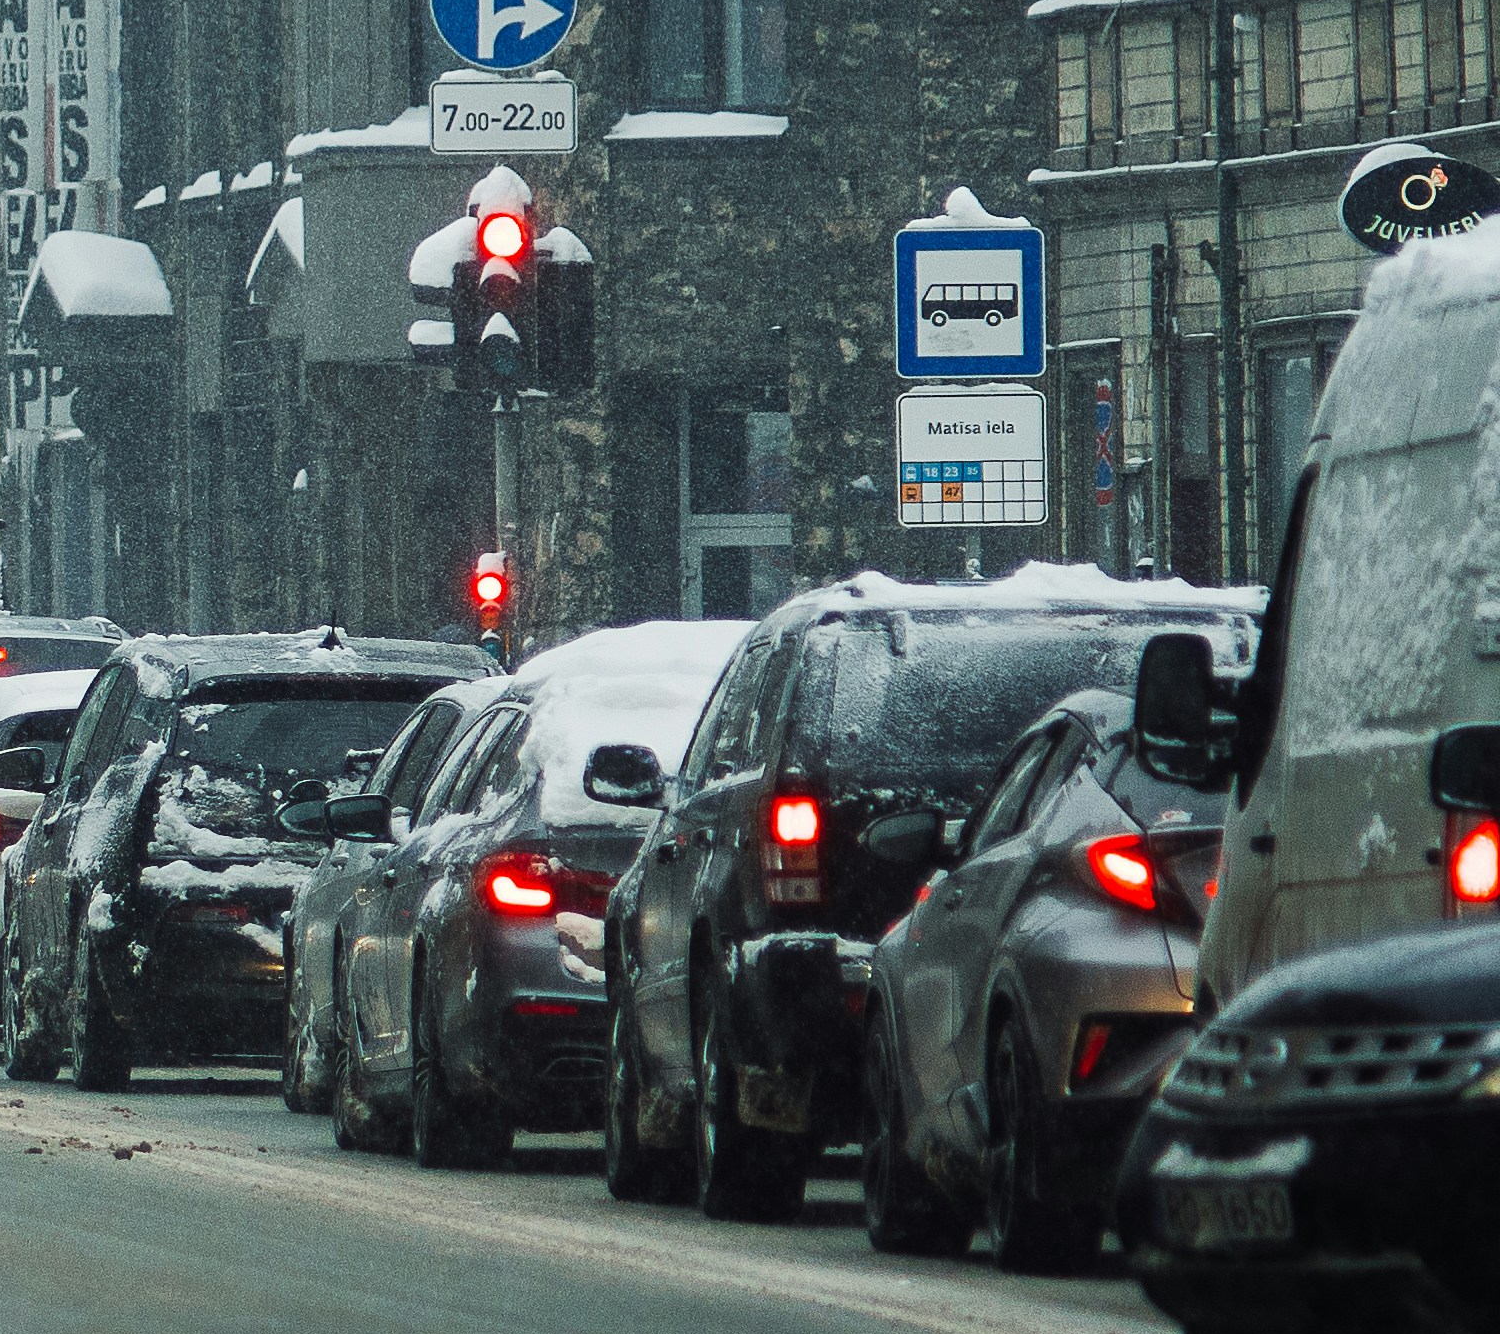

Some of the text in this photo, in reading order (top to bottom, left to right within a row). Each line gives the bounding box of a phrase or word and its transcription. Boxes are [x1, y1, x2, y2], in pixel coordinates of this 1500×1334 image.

[442, 103, 565, 132] 7.00-22.00
[928, 420, 1015, 435] Matīsa iela
[924, 467, 938, 478] 18
[944, 466, 959, 478] 23
[944, 486, 960, 498] 47
